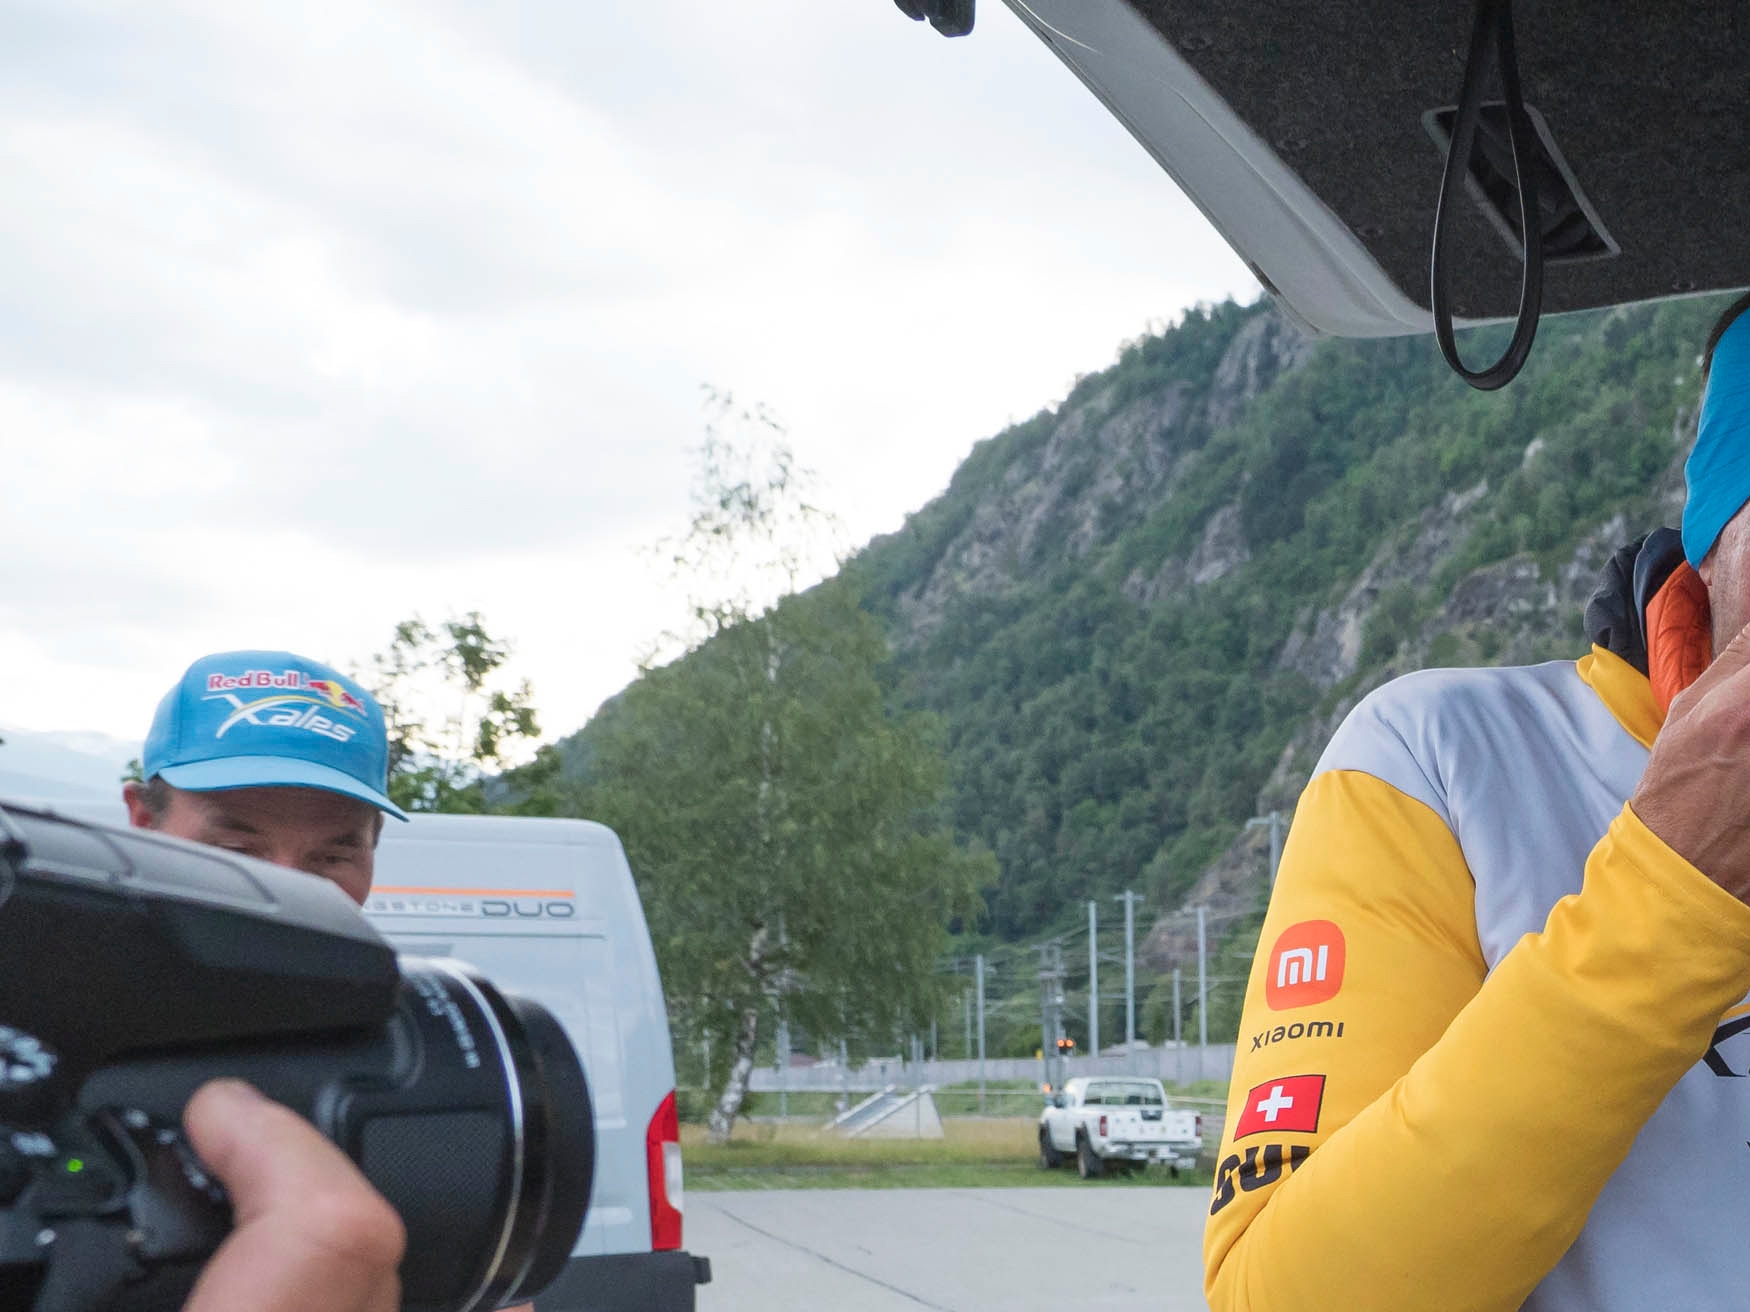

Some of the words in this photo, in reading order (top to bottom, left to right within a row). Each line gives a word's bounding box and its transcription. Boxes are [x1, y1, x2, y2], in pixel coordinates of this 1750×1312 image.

[207, 673, 252, 692] Red
[255, 669, 299, 690] Bull
[481, 900, 574, 918] DUO
